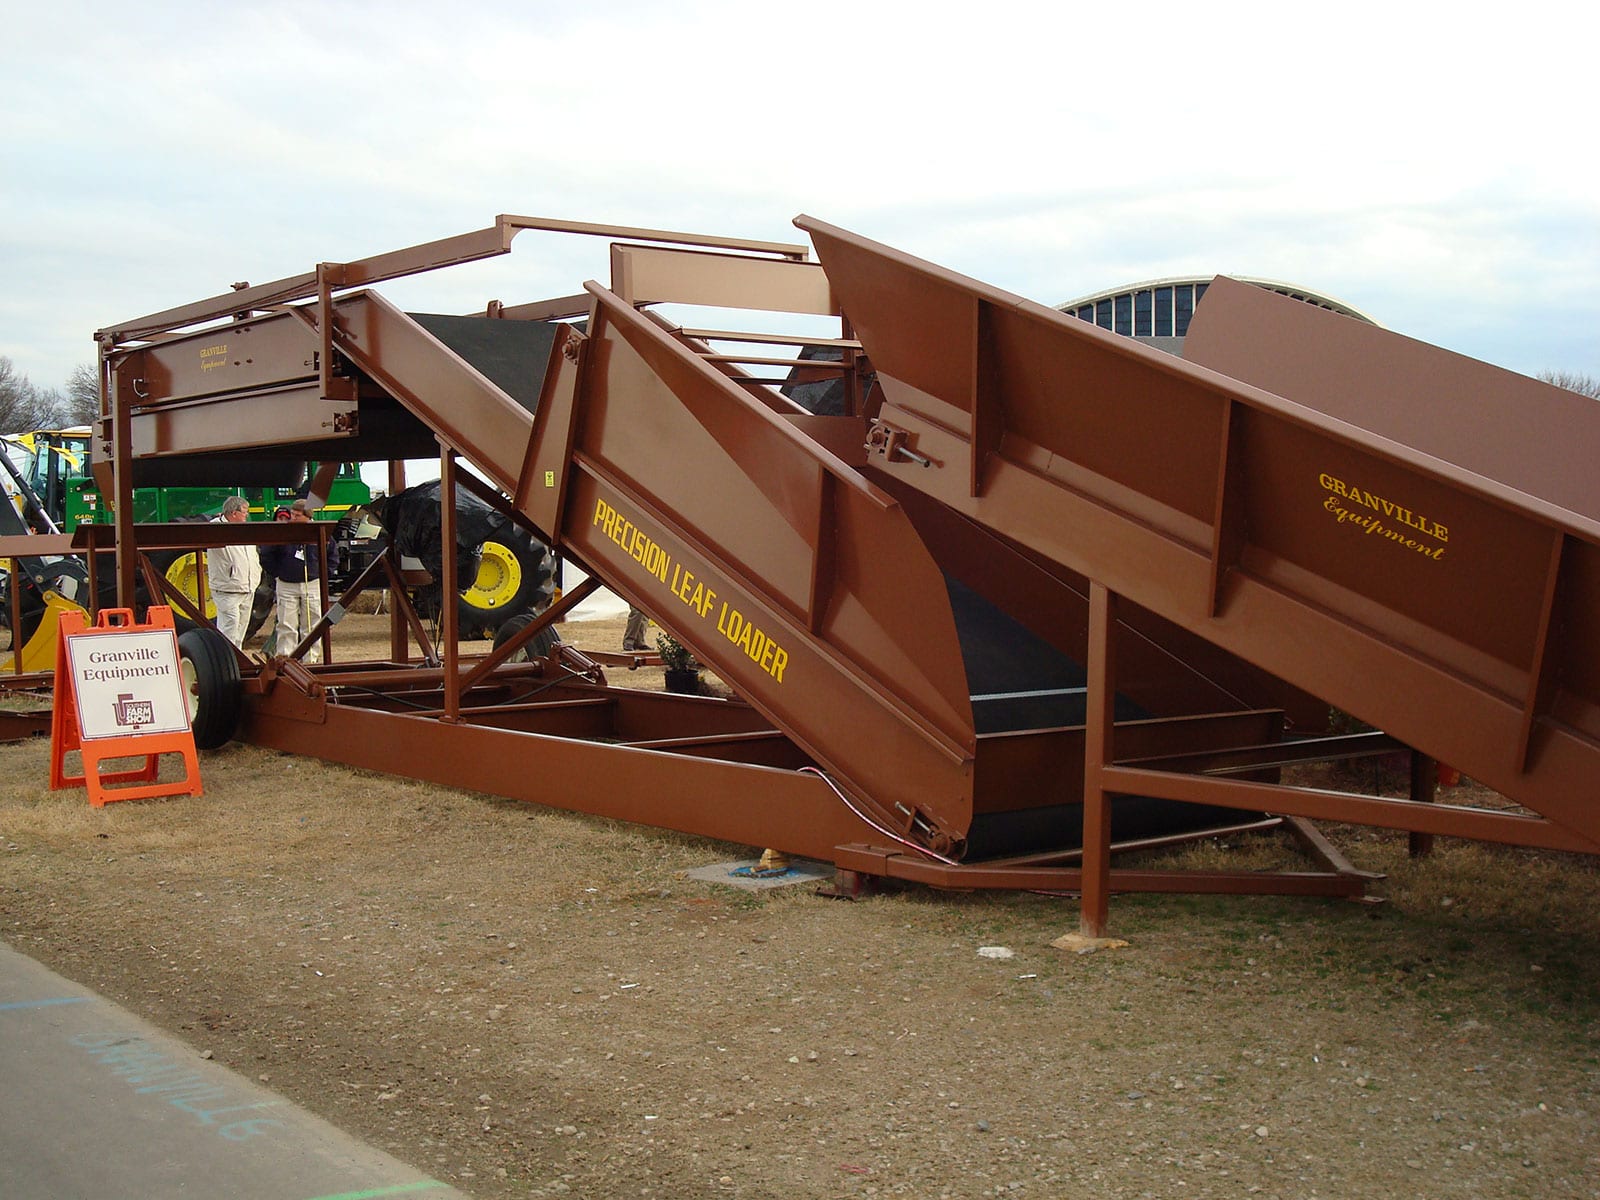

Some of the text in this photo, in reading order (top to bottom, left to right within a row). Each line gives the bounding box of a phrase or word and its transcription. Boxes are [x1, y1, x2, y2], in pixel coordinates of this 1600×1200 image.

[1319, 473, 1449, 543] GRANVILLE
[1323, 496, 1445, 561] Equipment
[593, 498, 789, 684] PRECISION LEAF LOADER
[89, 648, 159, 663] Granville
[83, 664, 169, 681] Equipment
[126, 706, 151, 718] FARM
[126, 714, 151, 724] SHOW
